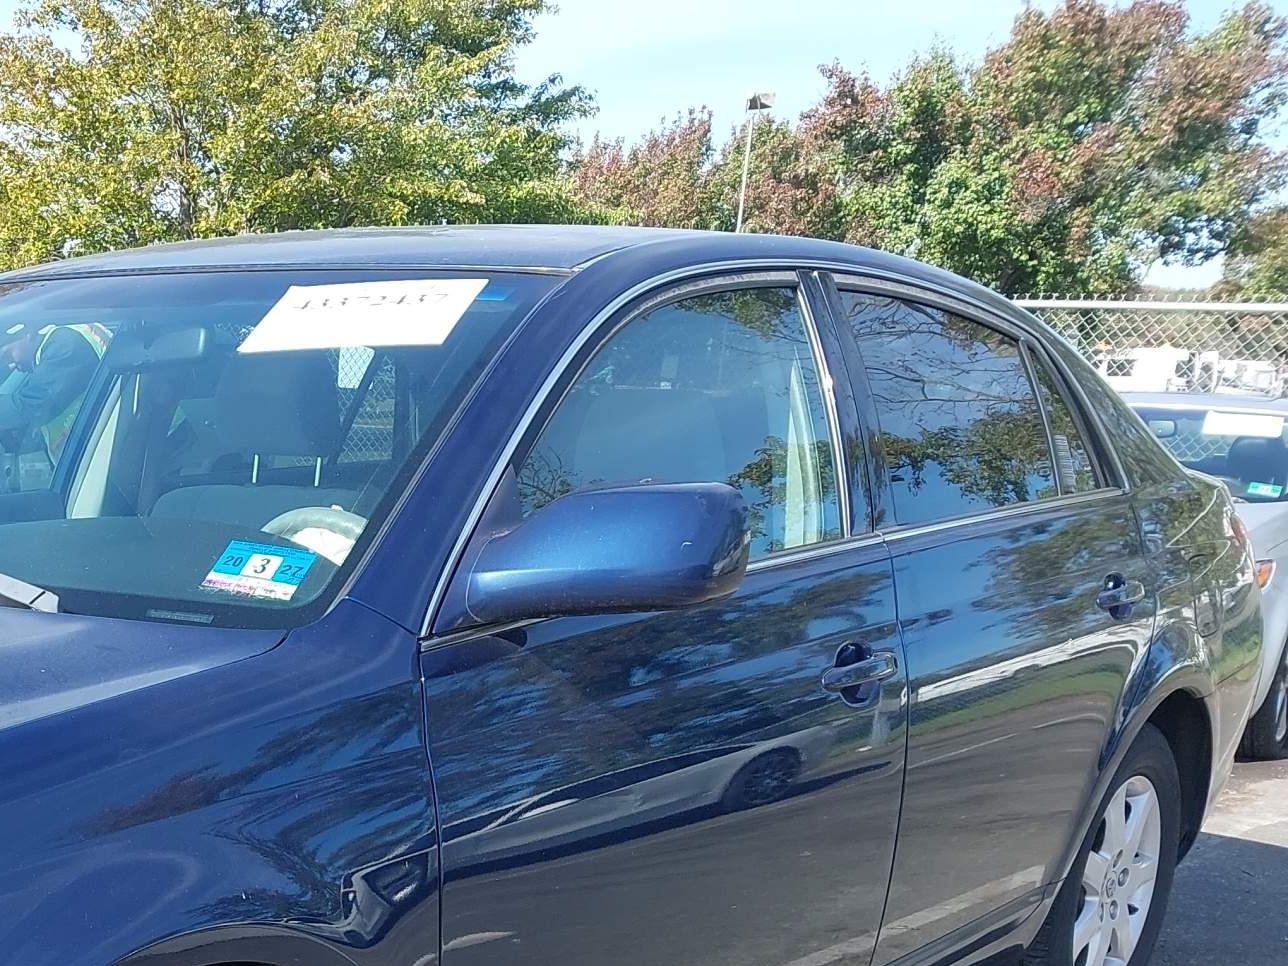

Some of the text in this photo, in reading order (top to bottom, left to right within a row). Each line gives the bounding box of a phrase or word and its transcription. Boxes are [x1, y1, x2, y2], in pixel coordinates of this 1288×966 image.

[222, 555, 304, 577] 20 3 27
